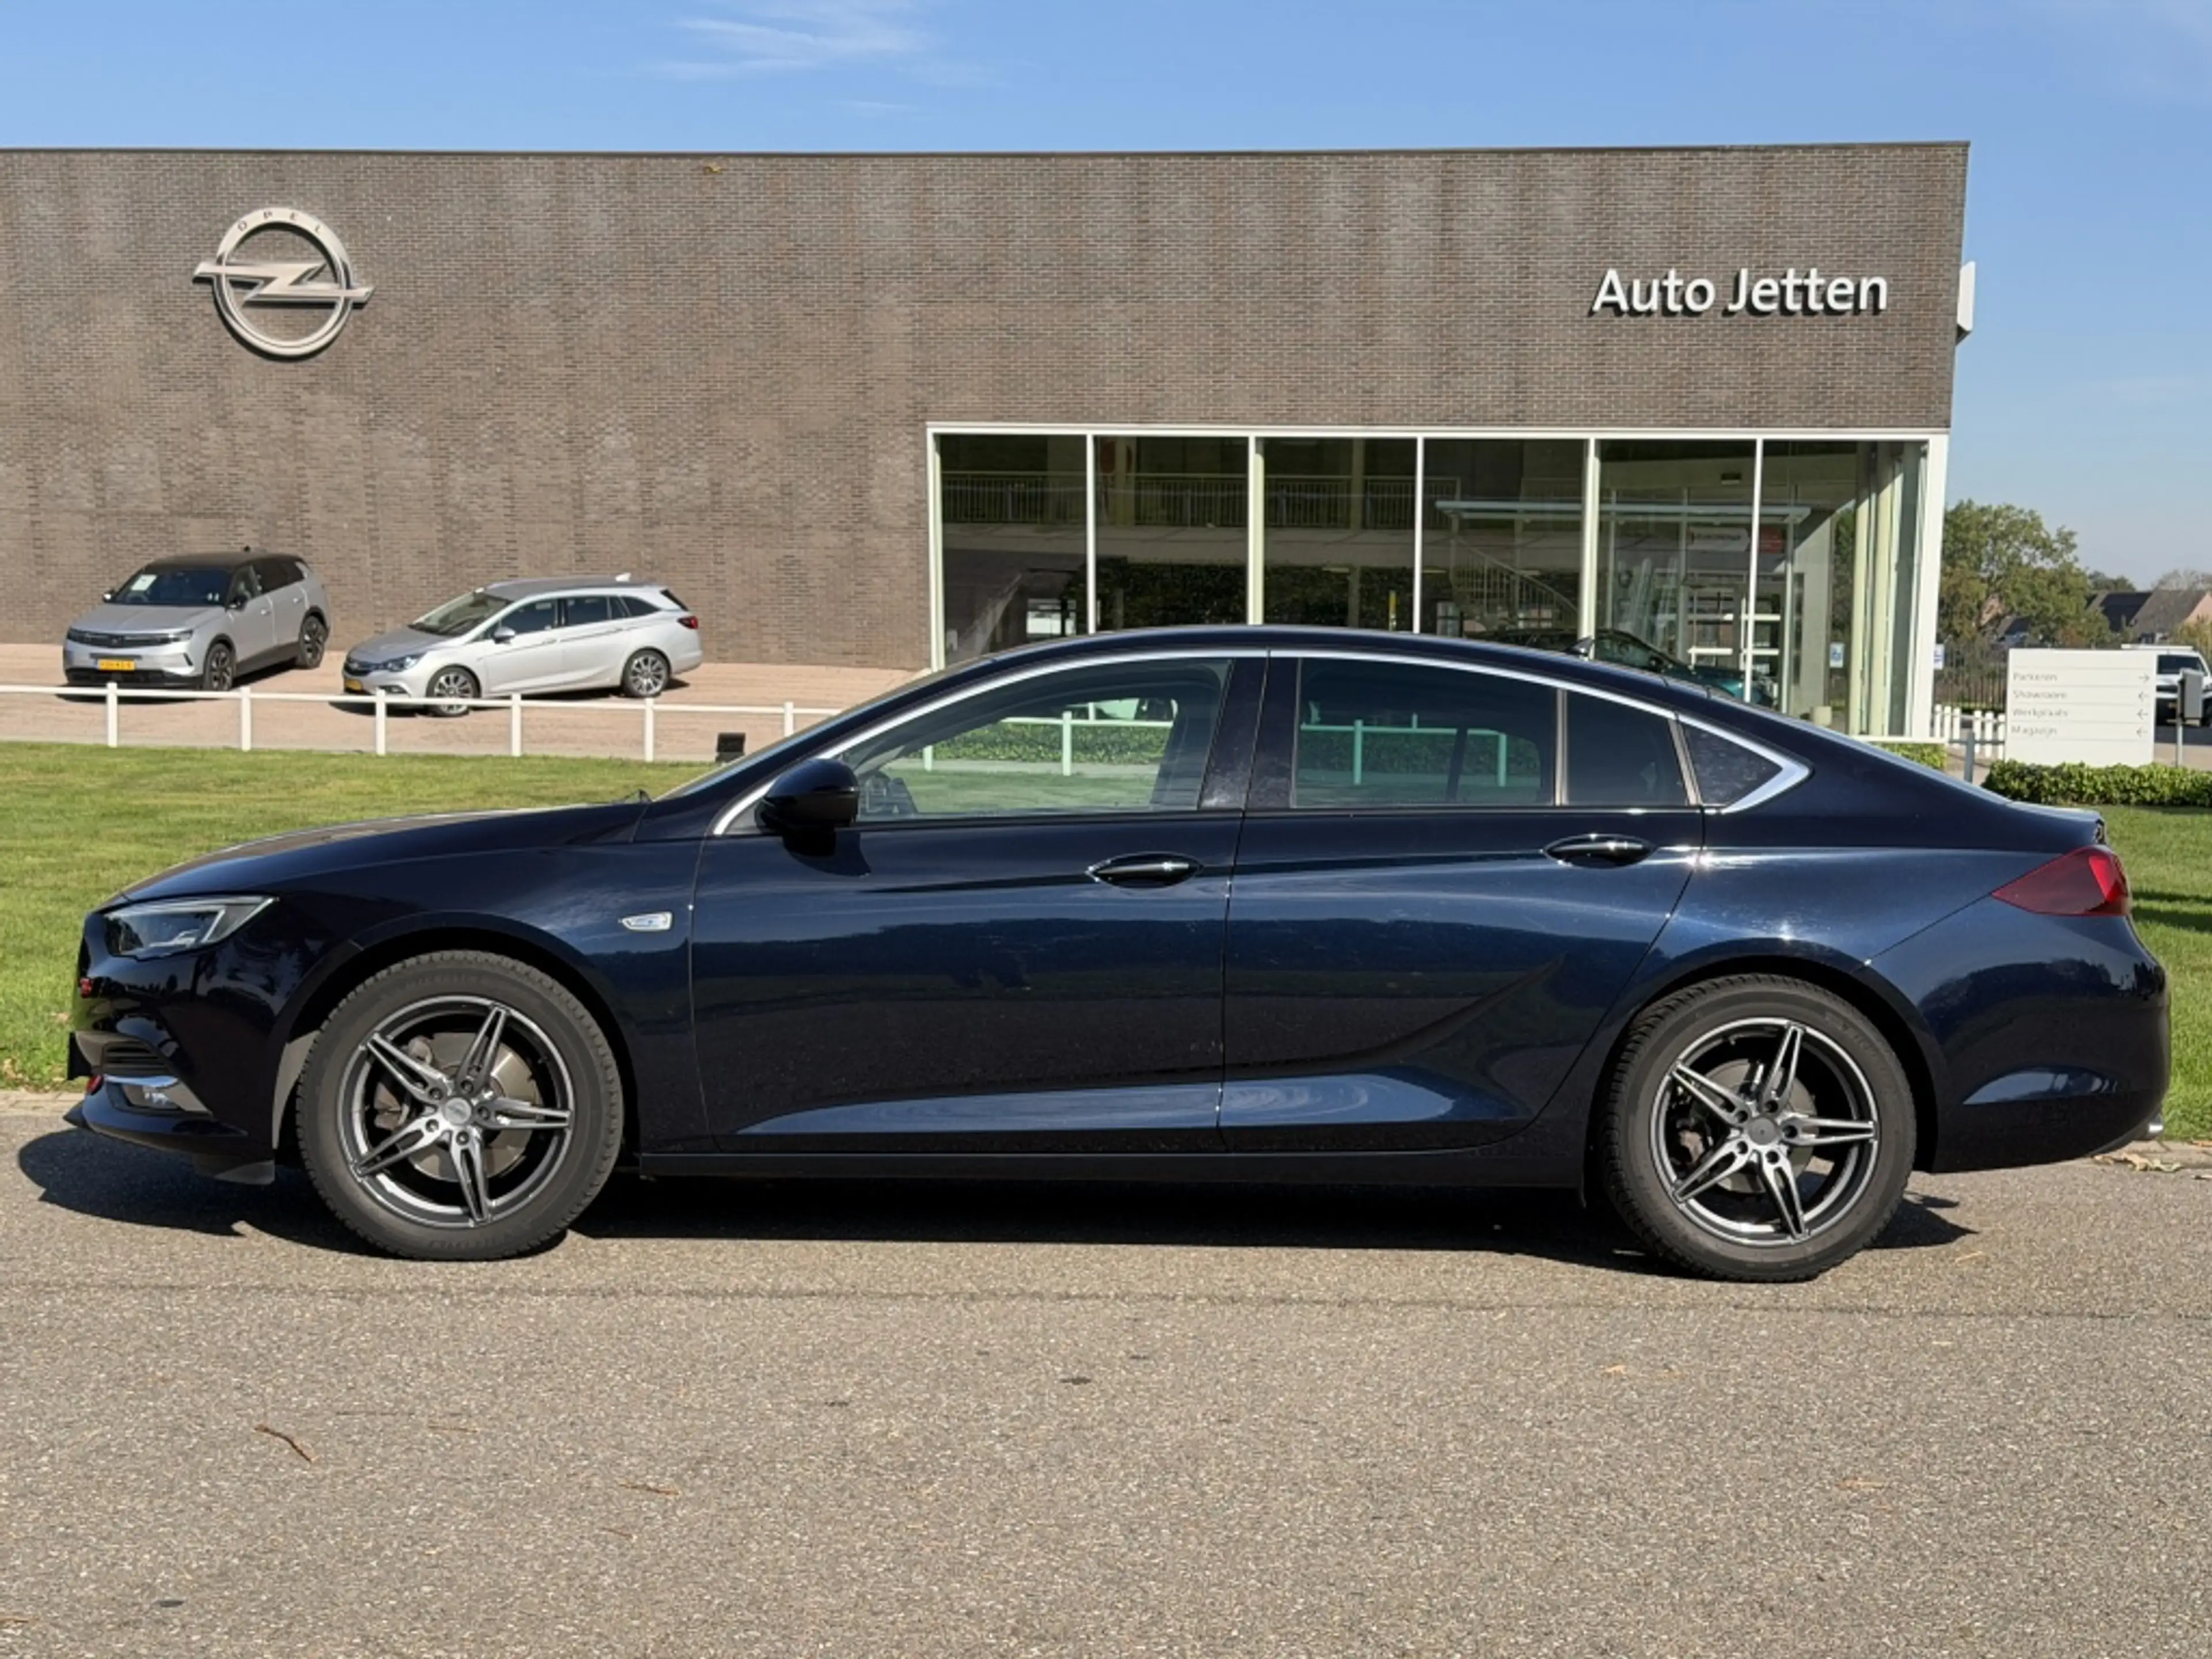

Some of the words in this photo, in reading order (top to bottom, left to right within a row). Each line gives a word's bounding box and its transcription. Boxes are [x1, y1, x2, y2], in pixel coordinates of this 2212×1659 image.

[237, 210, 321, 233] OPEL
[1592, 268, 1716, 312] Auto
[1727, 267, 1888, 312] Jetten
